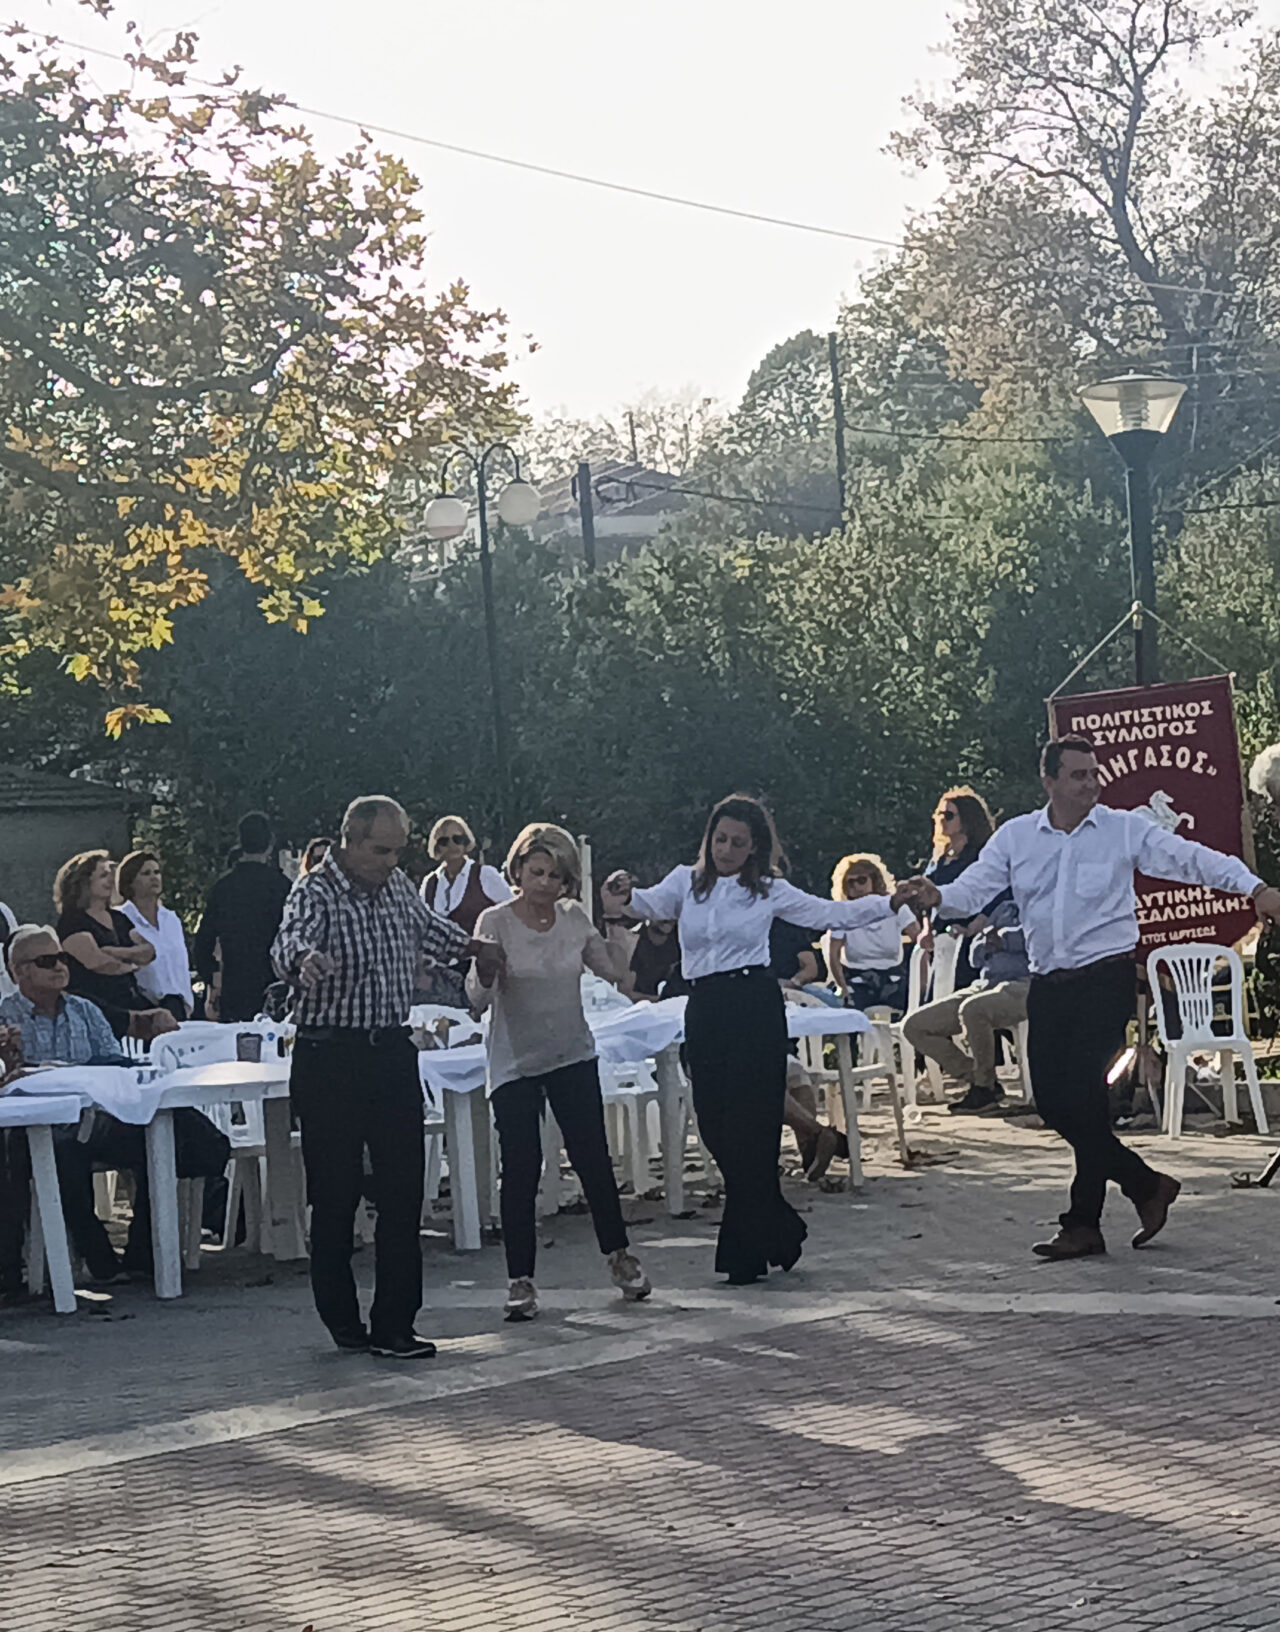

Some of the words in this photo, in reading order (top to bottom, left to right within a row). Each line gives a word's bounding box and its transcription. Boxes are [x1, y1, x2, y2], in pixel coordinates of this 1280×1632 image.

[1071, 700, 1214, 731] ΠΟΛΙΤΙΣΤΙΚΟΣ
[1092, 720, 1197, 746] ΣΥΛΛΟΓΟΣ
[1136, 896, 1250, 924] ΣΑΛΟΝΙΚΗΣ
[1142, 932, 1166, 945] ΕΤΟΣ
